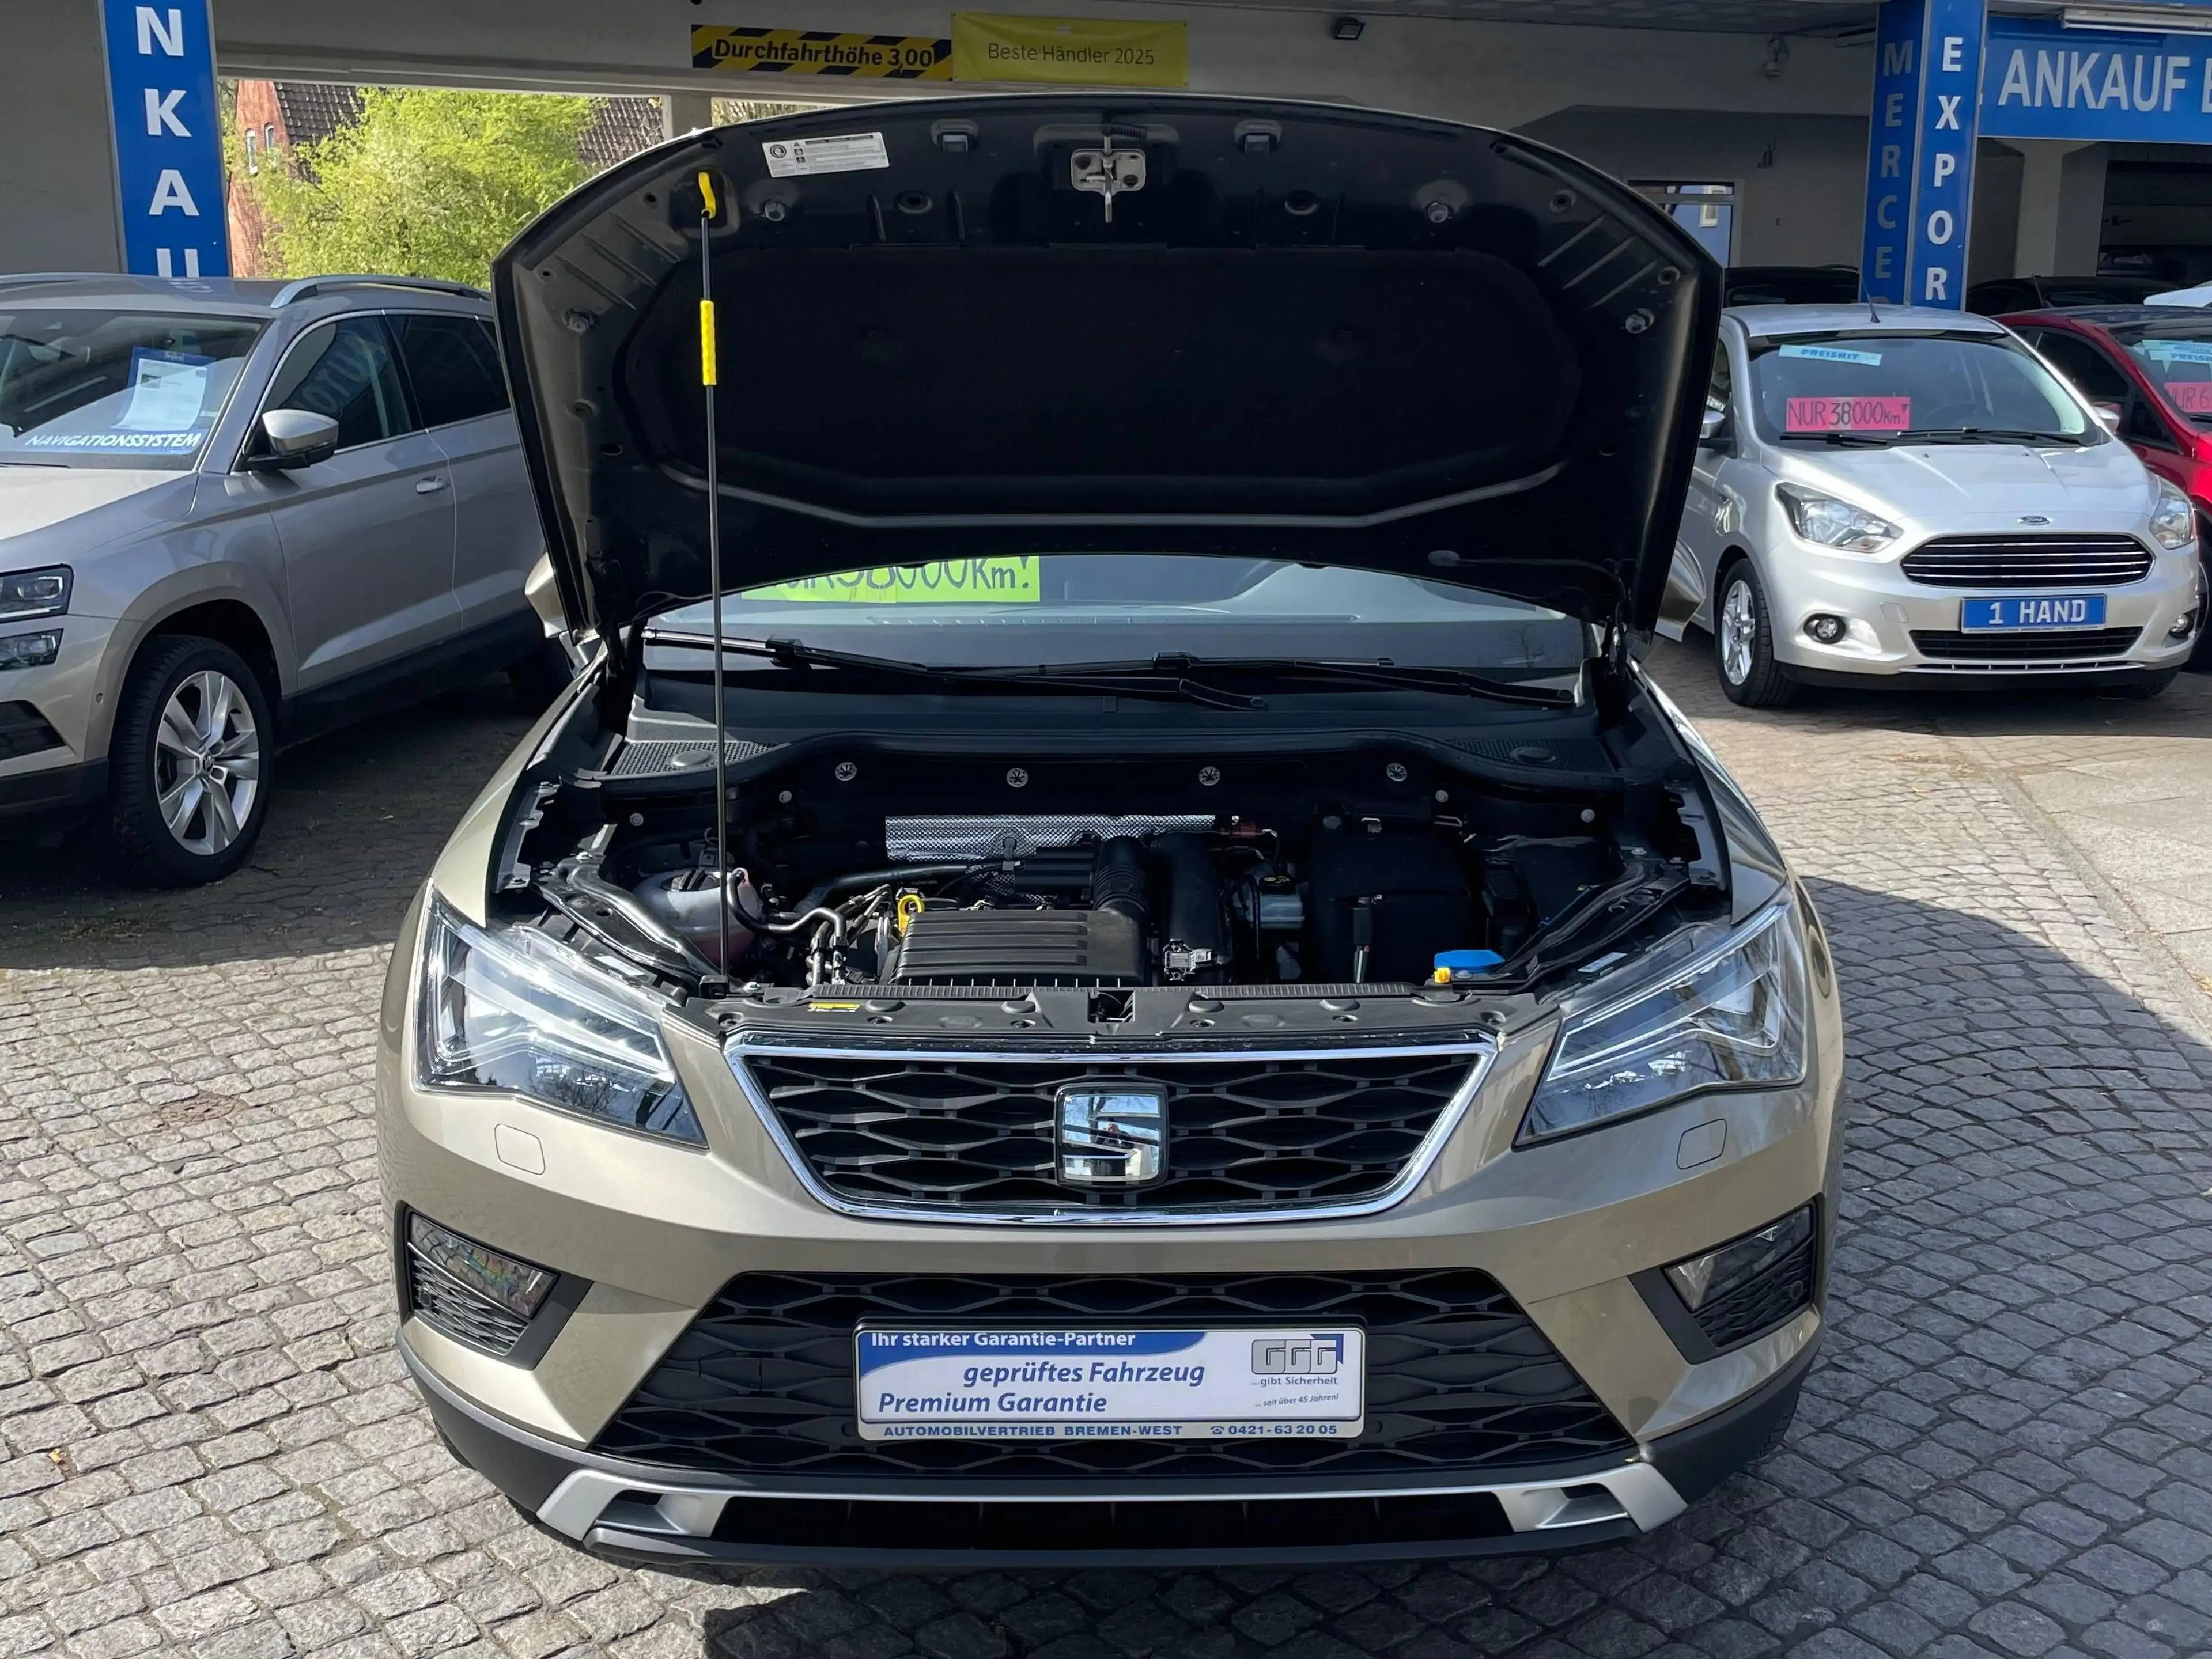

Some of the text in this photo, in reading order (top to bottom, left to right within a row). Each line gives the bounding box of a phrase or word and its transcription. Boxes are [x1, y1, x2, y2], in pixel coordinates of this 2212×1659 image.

[714, 39, 882, 66] Durchfahrthöhe
[988, 43, 1154, 65] Beste Händler 2025
[1998, 49, 2190, 112] ANKAUF
[1869, 40, 1914, 304] MERCE
[1801, 348, 1860, 360] PREISHIT
[1788, 401, 1826, 426] NUR
[24, 433, 202, 448] NAVIGATIONSSYSTEM
[1989, 600, 2086, 624] 1 HAND
[872, 1332, 1136, 1346] Ihr starker Garantie-Partner
[963, 1361, 1205, 1387] geprüftes Fahrzeug
[1285, 1376, 1337, 1385] Sicherheit
[879, 1392, 1107, 1412] Premium Garantie
[1279, 1397, 1296, 1406] über
[884, 1426, 1055, 1436] AUTOMOBILVERTRIEB
[1064, 1426, 1182, 1436] BREMEN-WEST
[1296, 1425, 1315, 1434] 20
[1318, 1425, 1337, 1434] 05
